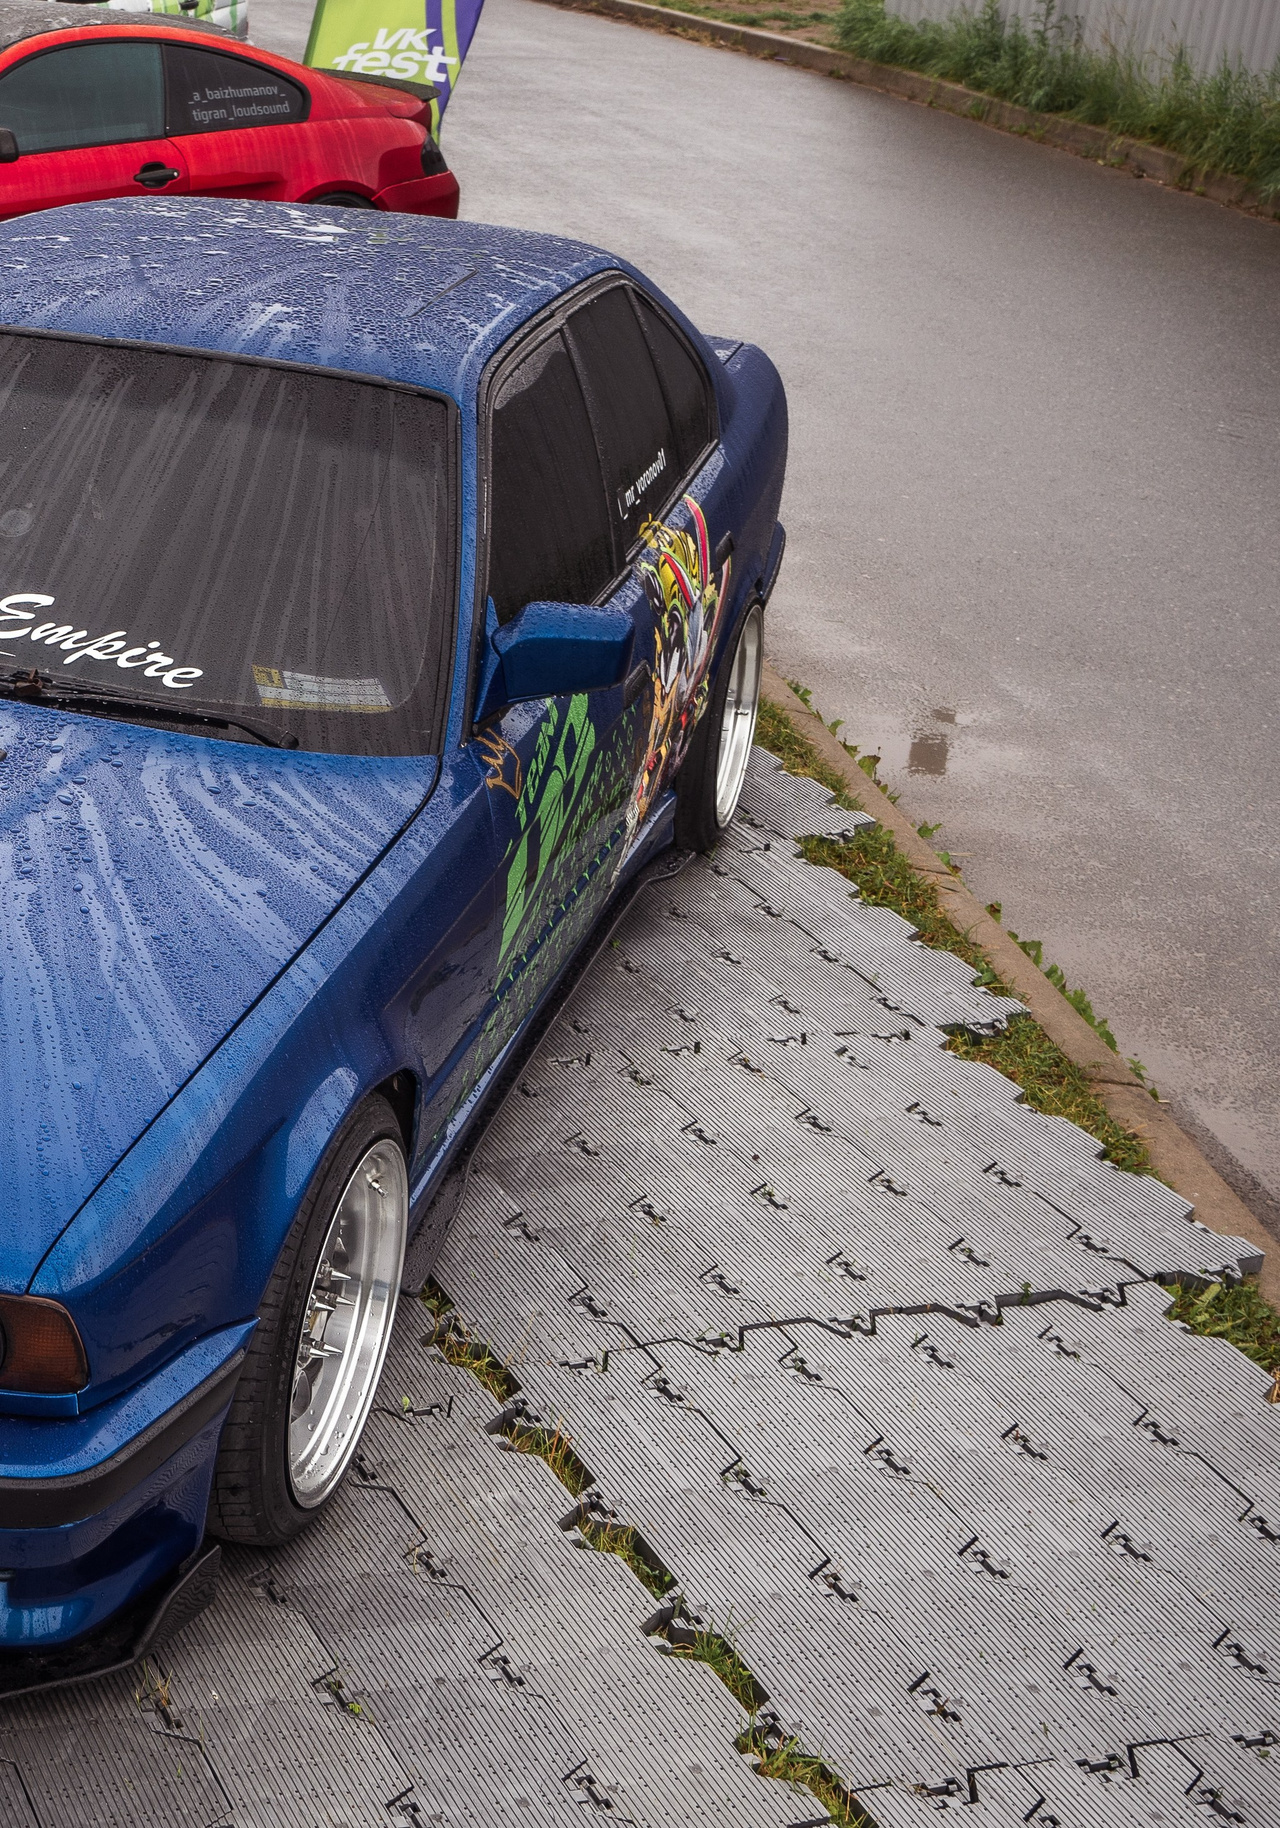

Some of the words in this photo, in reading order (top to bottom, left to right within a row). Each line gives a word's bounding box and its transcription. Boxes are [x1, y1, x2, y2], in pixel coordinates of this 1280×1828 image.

[373, 28, 437, 50] VK
[332, 42, 457, 83] fest
[192, 101, 291, 124] tigran_loudsound
